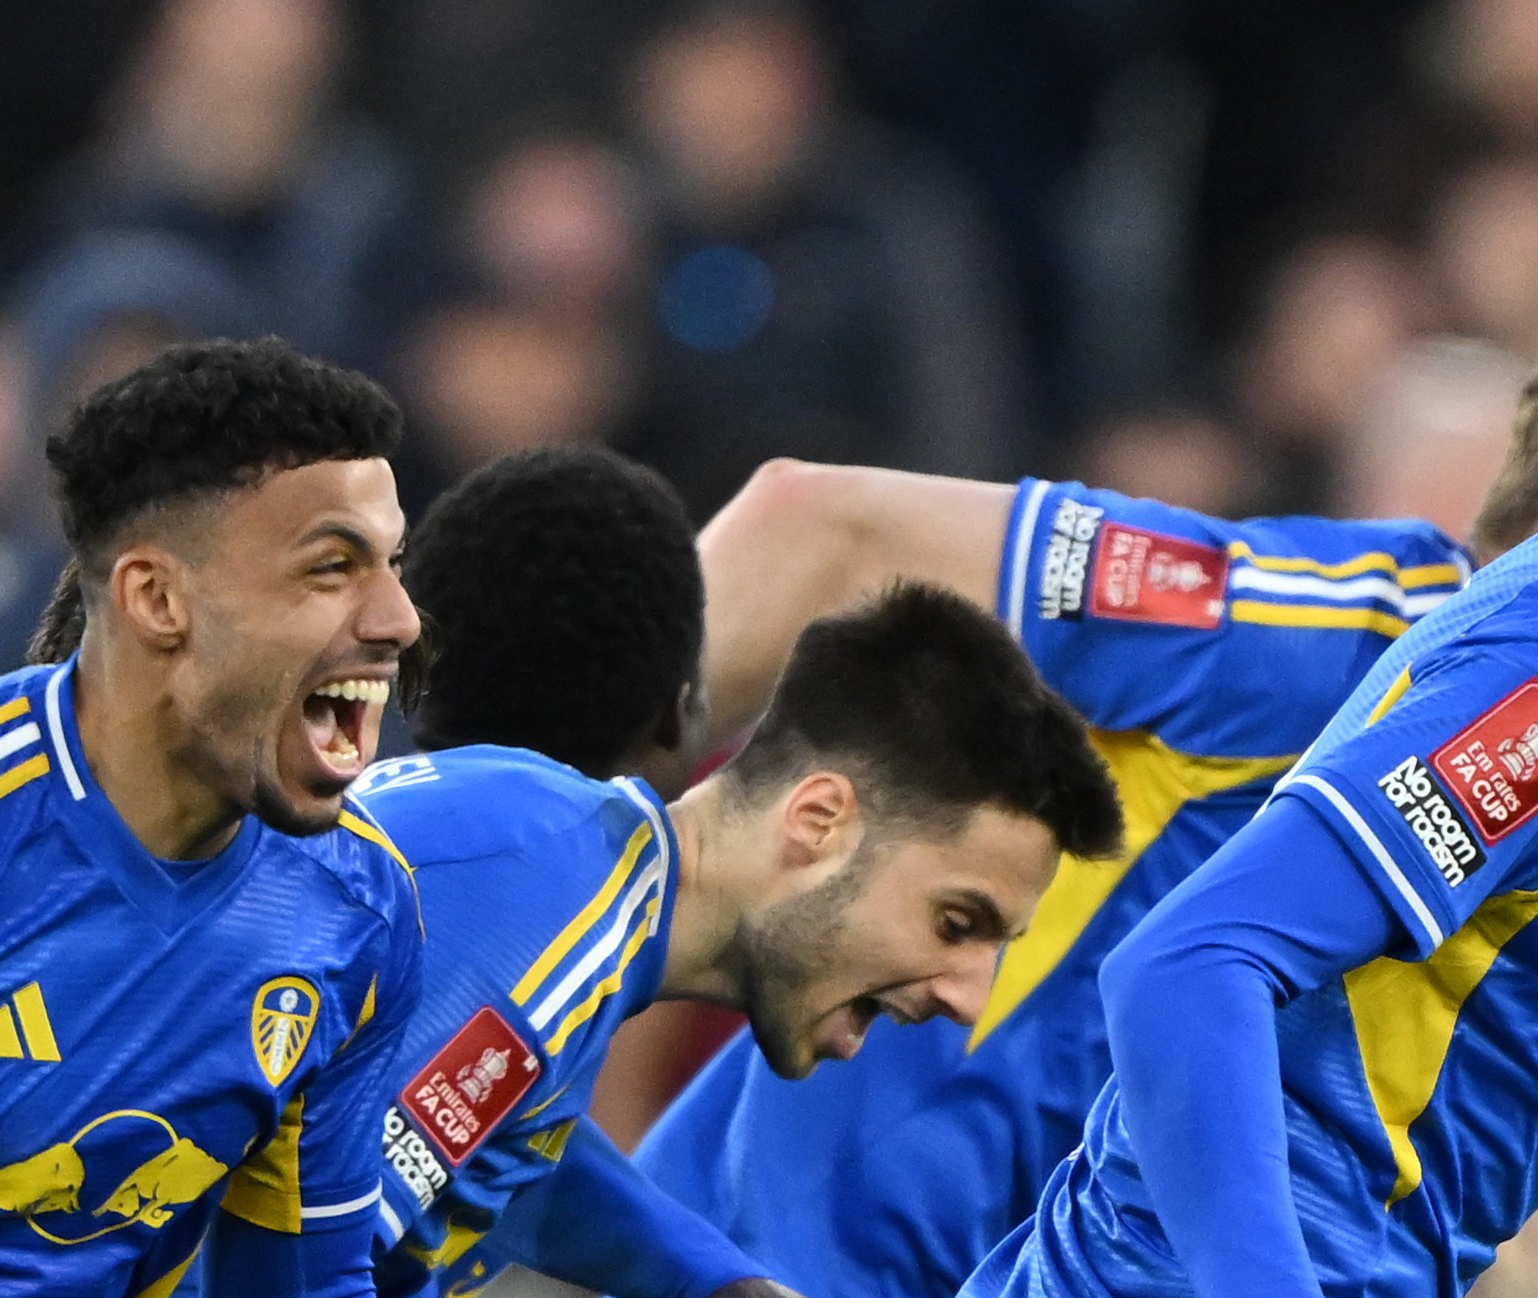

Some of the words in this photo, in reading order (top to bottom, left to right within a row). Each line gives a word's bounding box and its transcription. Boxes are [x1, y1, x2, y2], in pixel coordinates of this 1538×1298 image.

[1395, 755, 1432, 798] No
[1423, 794, 1477, 865] room
[1450, 752, 1477, 783] FA
[1472, 779, 1508, 821] CUP
[1466, 740, 1522, 812] Emrates
[1377, 769, 1417, 808] for
[1404, 805, 1465, 888] racism
[415, 1085, 440, 1114] FA
[435, 1108, 471, 1144] CUP
[430, 1071, 481, 1133] Emirates
[384, 1106, 405, 1136] o
[399, 1129, 448, 1190] room
